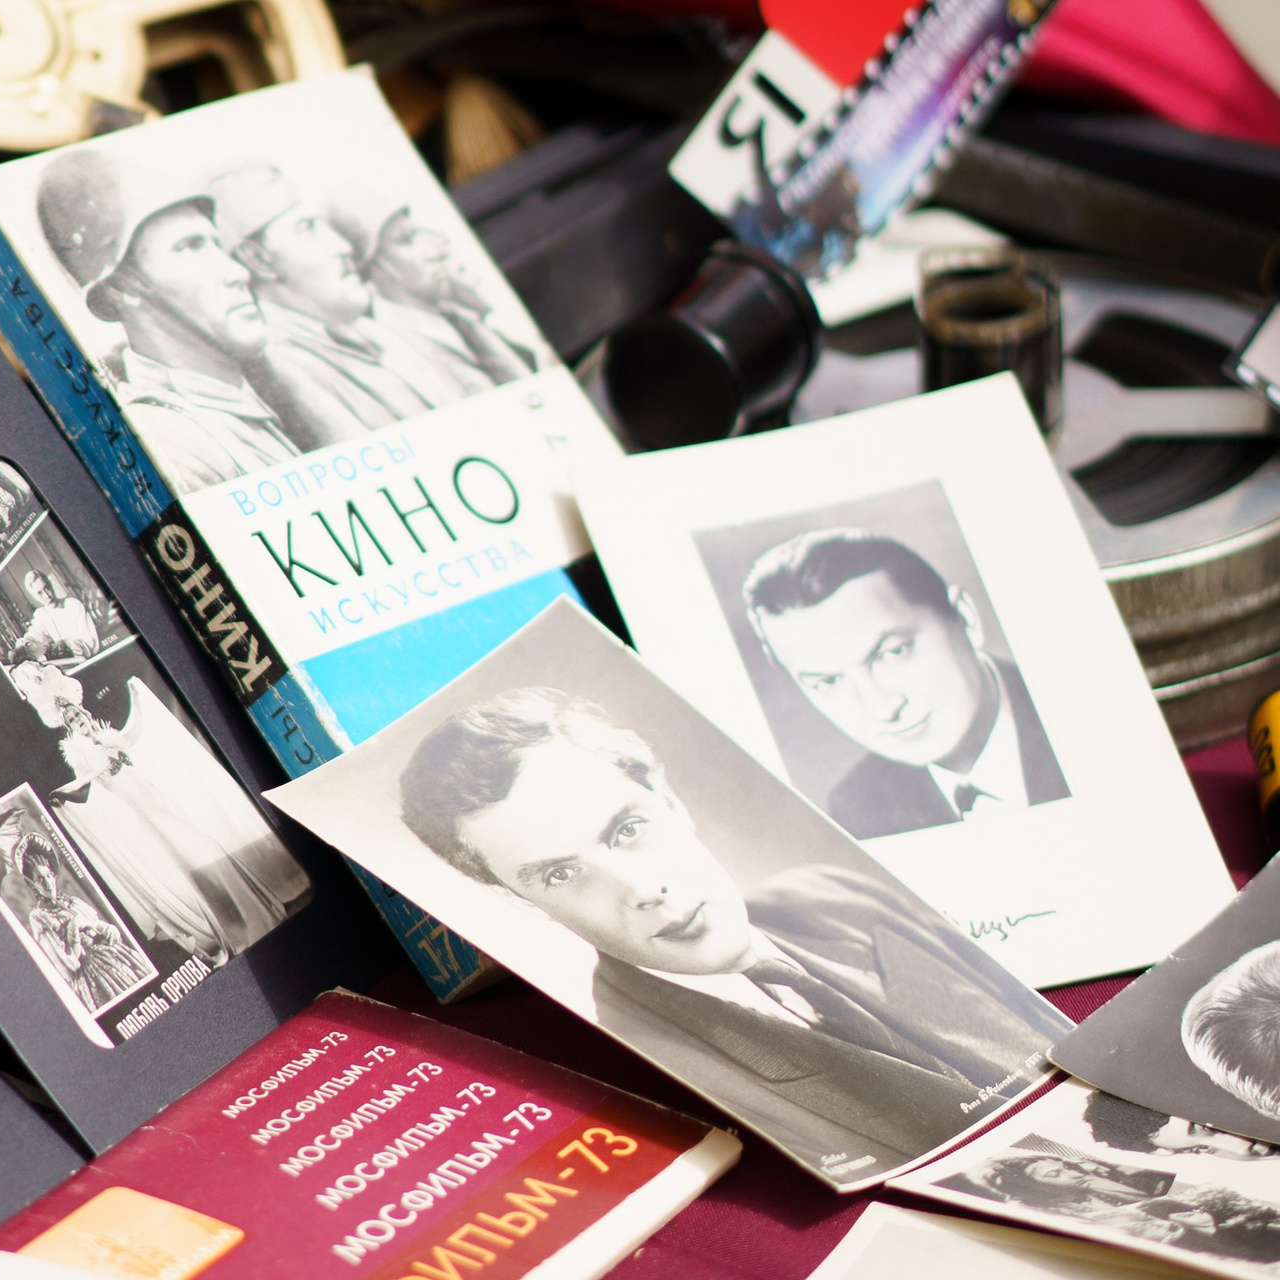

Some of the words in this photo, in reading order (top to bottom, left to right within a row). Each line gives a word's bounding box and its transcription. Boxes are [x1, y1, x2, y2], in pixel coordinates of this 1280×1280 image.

[11, 276, 153, 496] ИСКУССТВА
[228, 435, 416, 516] ВОПРОСЫ
[251, 455, 520, 598] КИНО
[157, 523, 273, 693] КИНО
[308, 539, 533, 634] ИСКУССТВА
[116, 992, 170, 1040] ЛЮБОВЬ
[160, 954, 212, 1004] ОРЛОВА
[418, 923, 461, 984] 17
[222, 1031, 348, 1119] МОСФИЛЬМ-73
[250, 1045, 396, 1145] МОСФИЛЬМ-73
[279, 1061, 443, 1177] МОСФИЛЬМ-73
[315, 1082, 497, 1211] МОСФИЛЬМ-73
[331, 1102, 552, 1266] МОСФИЛЬМ-73
